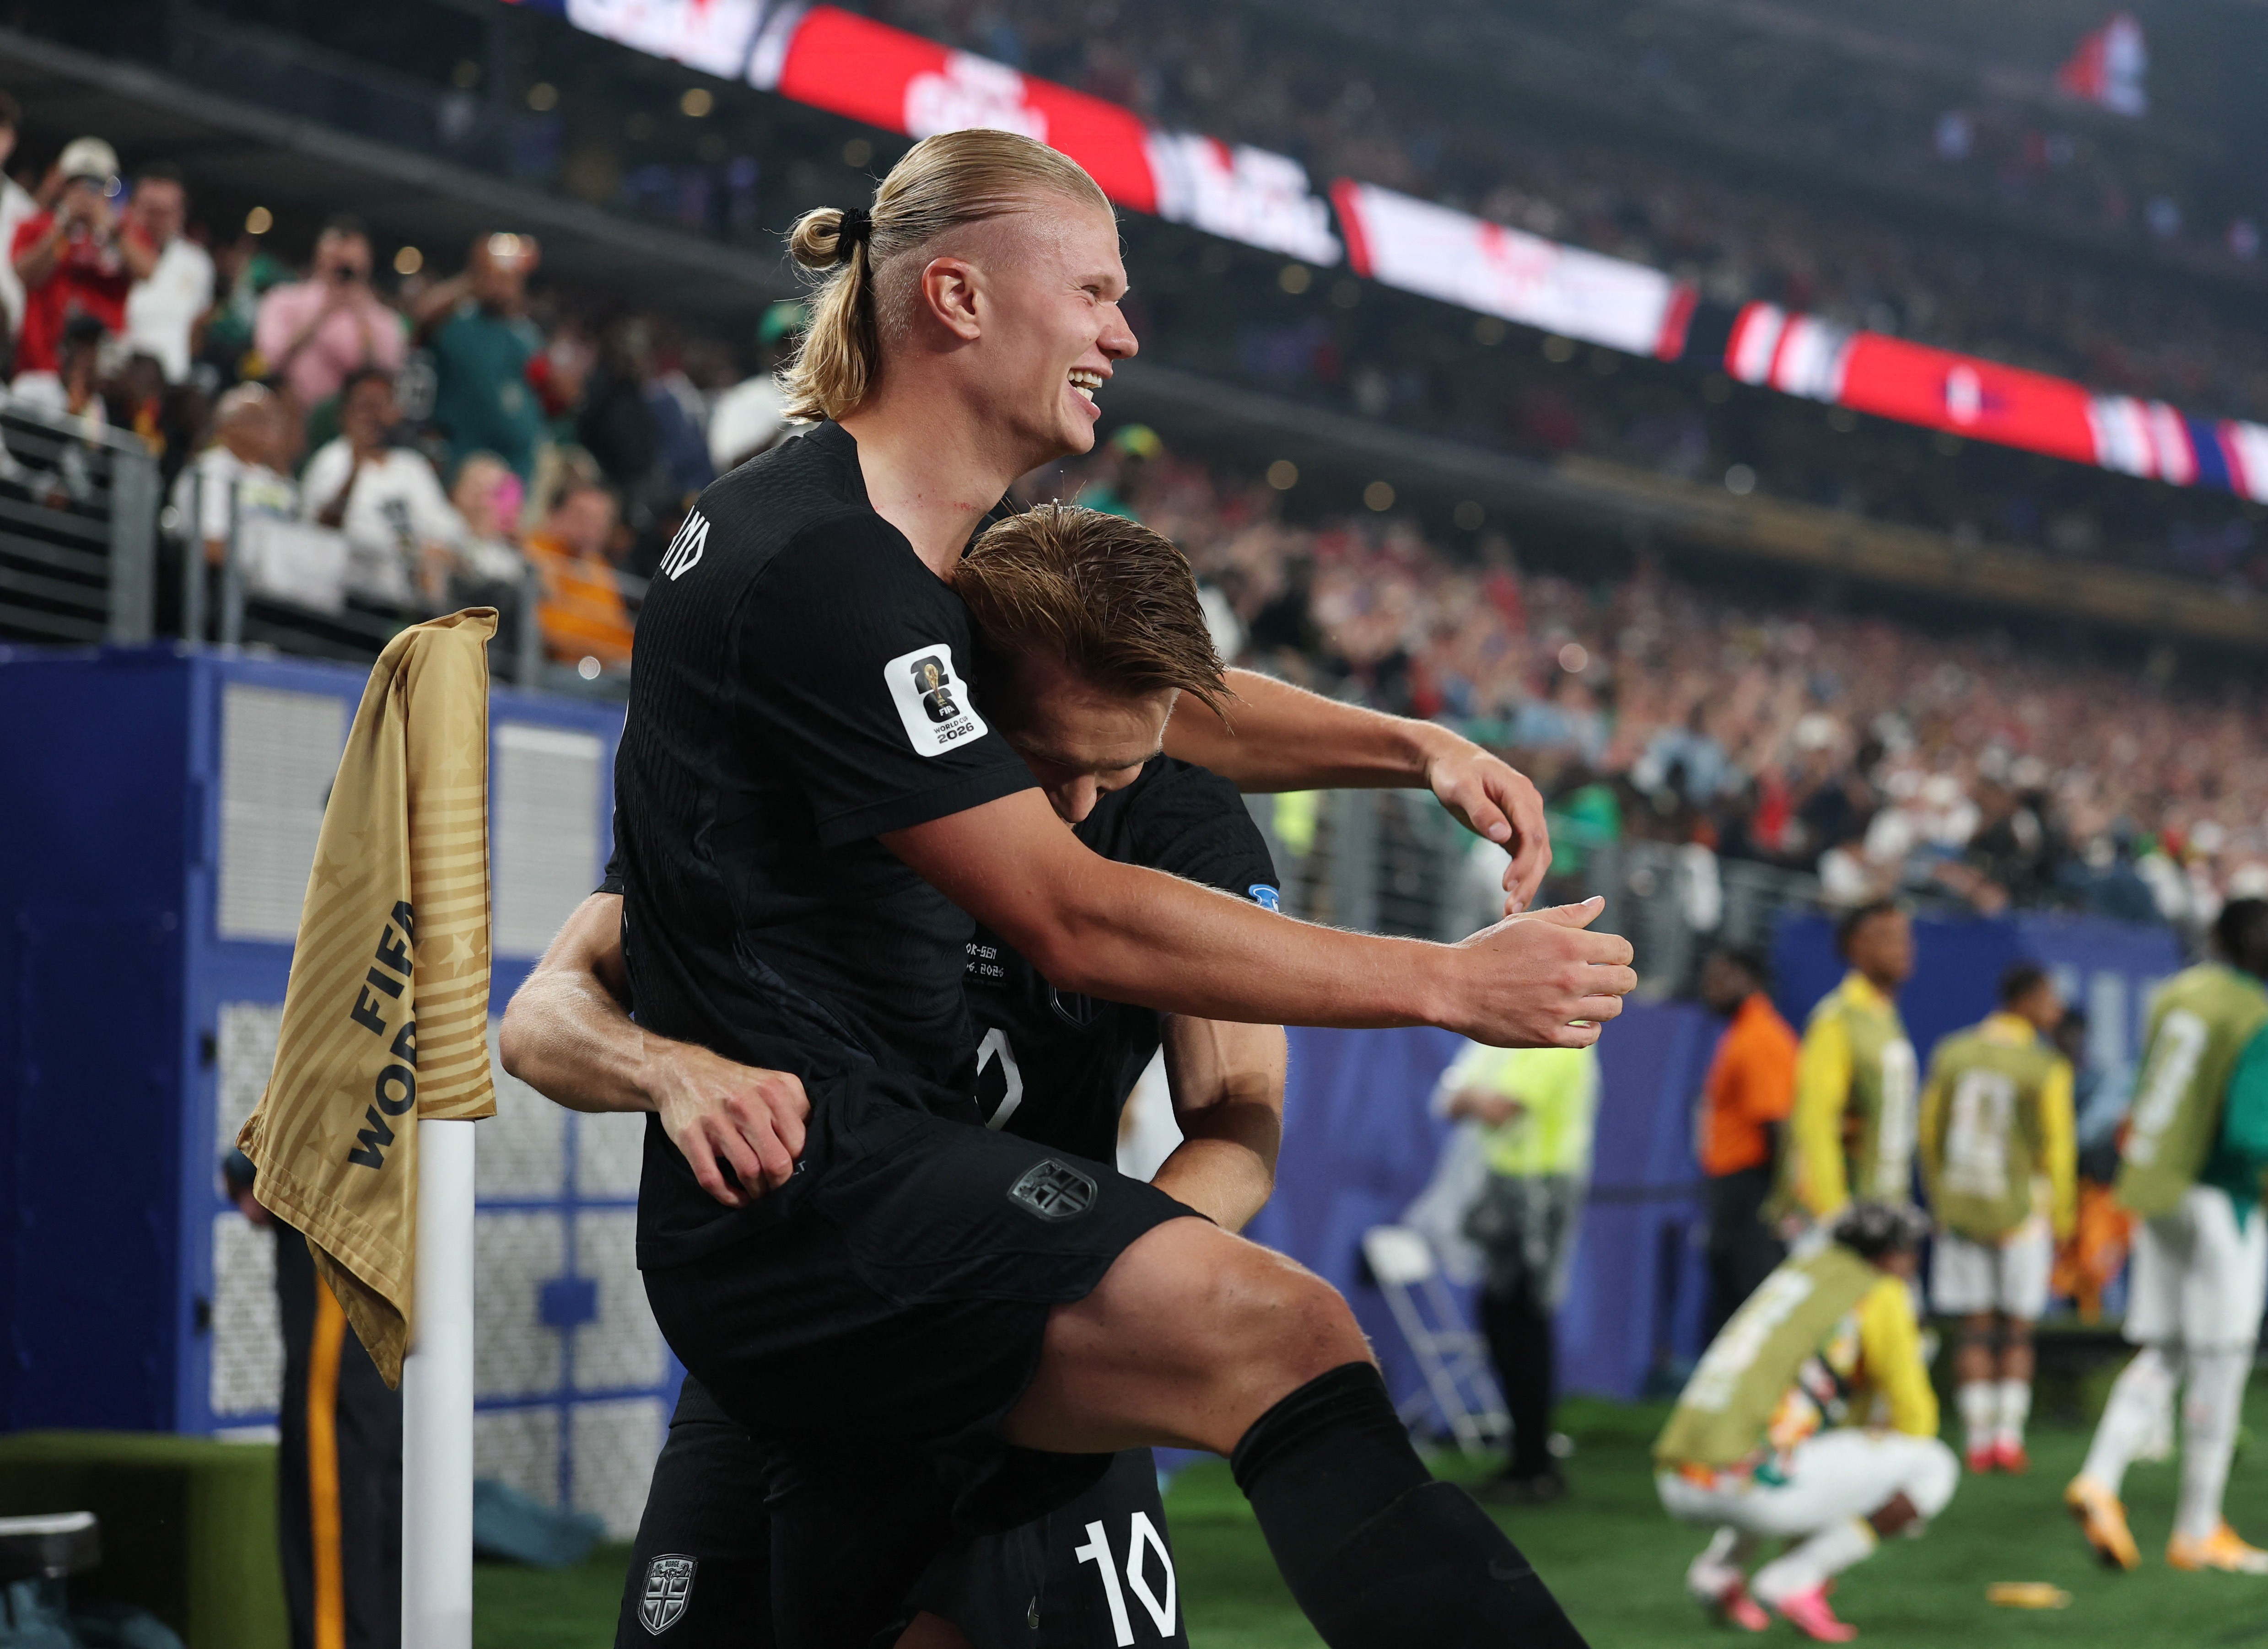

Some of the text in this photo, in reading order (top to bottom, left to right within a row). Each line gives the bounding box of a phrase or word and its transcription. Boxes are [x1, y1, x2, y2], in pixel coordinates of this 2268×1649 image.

[659, 505, 711, 581] ND
[938, 705, 955, 716] FIFA
[934, 720, 959, 734] WORLD
[937, 722, 974, 744] 2026
[966, 943, 997, 960] OR-SEN
[966, 961, 1004, 978] 6.2026
[347, 999, 417, 1170] WOR
[1074, 1511, 1176, 1648] 10
